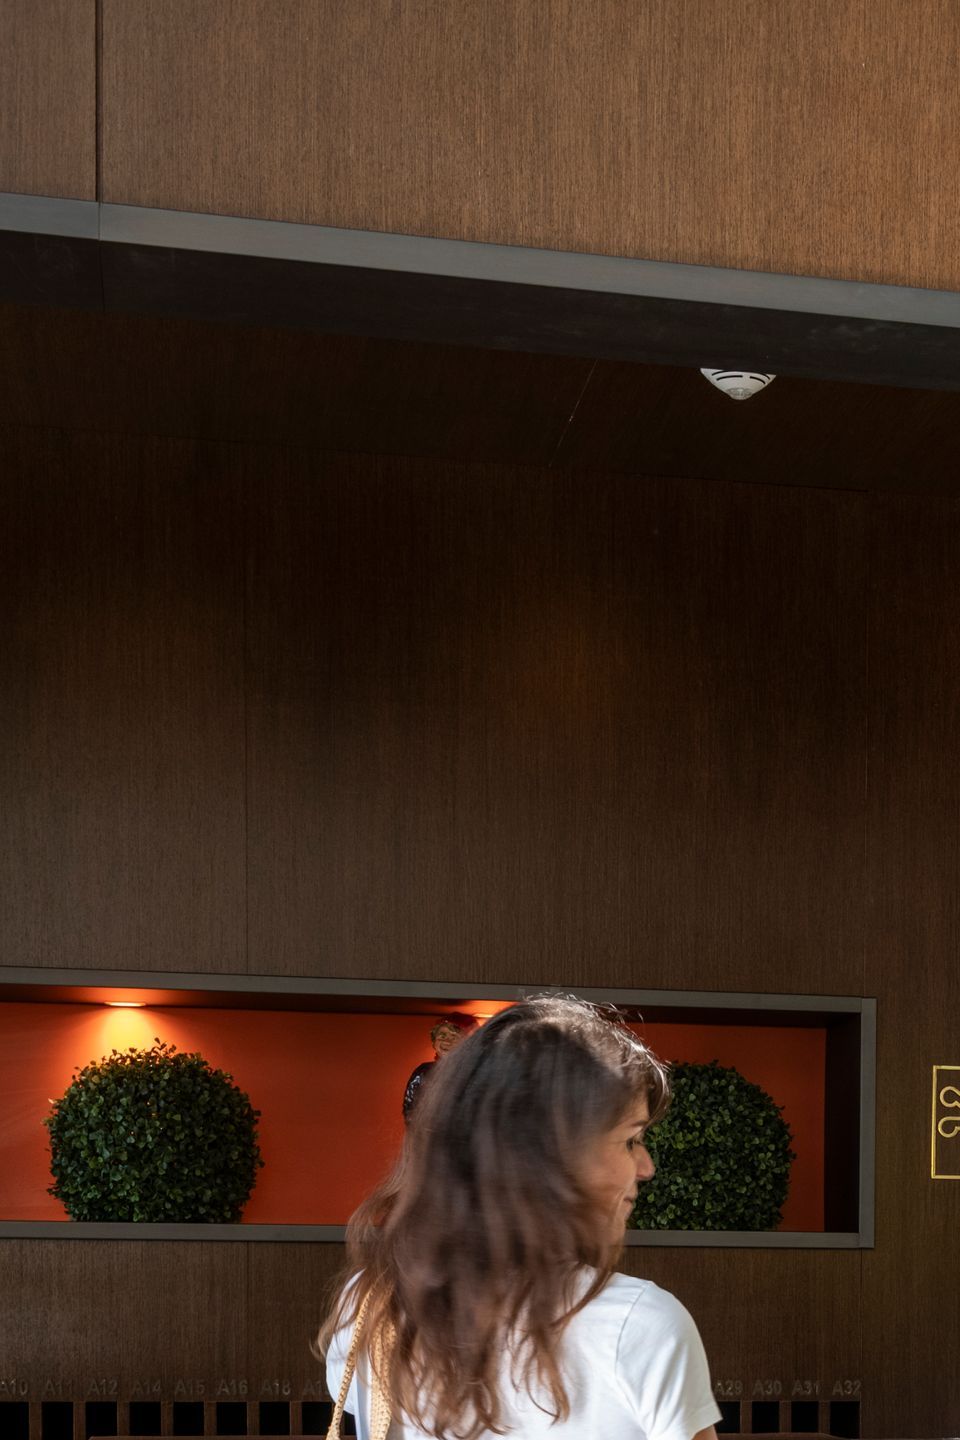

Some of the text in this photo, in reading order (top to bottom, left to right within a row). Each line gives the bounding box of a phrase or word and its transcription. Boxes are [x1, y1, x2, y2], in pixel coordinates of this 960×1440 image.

[45, 1378, 73, 1396] A11
[87, 1378, 119, 1396] A12
[131, 1378, 162, 1396] A14
[174, 1378, 205, 1396] A15
[216, 1378, 249, 1396] A16
[260, 1379, 291, 1396] A18
[304, 1379, 329, 1396] A1
[714, 1379, 743, 1396] A29
[752, 1379, 782, 1396] A30
[791, 1379, 820, 1396] A31
[831, 1379, 862, 1396] A32
